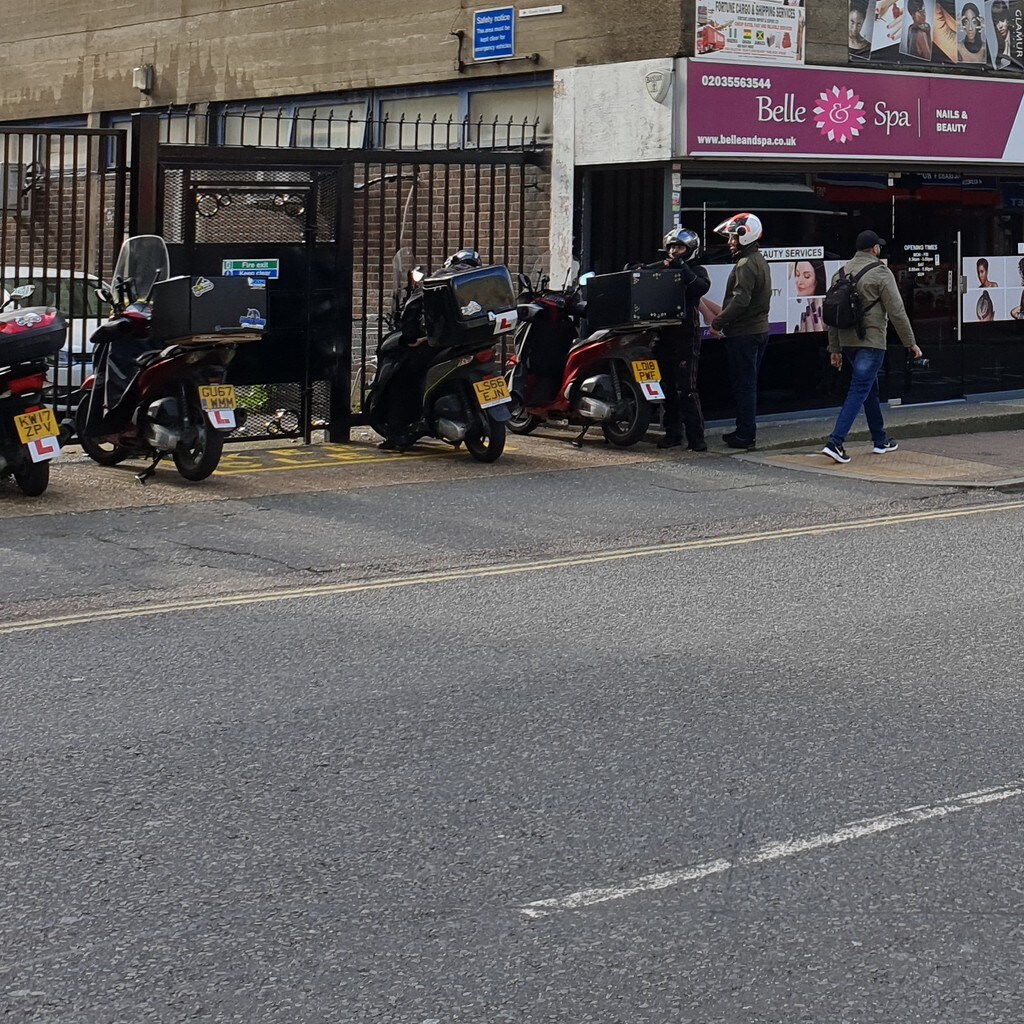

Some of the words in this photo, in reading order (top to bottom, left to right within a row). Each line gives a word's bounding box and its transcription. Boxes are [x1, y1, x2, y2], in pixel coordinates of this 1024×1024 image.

[715, 1, 735, 13] FORTUNE
[736, 3, 750, 15] CARGO
[756, 4, 775, 17] SHIPPING
[776, 7, 795, 19] SERVICES
[476, 16, 493, 25] Safety
[494, 14, 511, 22] notice
[1015, 9, 1023, 57] GLAMUR
[702, 75, 771, 89] 02035563544
[756, 93, 806, 123] Belle
[829, 102, 851, 124] &
[874, 101, 911, 135] Spa
[936, 109, 960, 119] NAILS
[961, 111, 968, 120] &
[936, 123, 966, 133] BEAUTY
[697, 134, 796, 147] www.belleandspa.co.uk
[760, 249, 783, 259] EAUTY
[785, 248, 822, 257] SERVICES
[500, 318, 512, 329] L
[201, 387, 233, 397] GU67
[476, 378, 505, 394] LS66
[646, 383, 659, 396] L
[483, 389, 506, 402] EJN
[211, 398, 234, 409] WMM
[20, 410, 51, 427] KW17
[214, 411, 230, 424] L
[25, 422, 52, 437] ZPV
[35, 439, 54, 455] L
